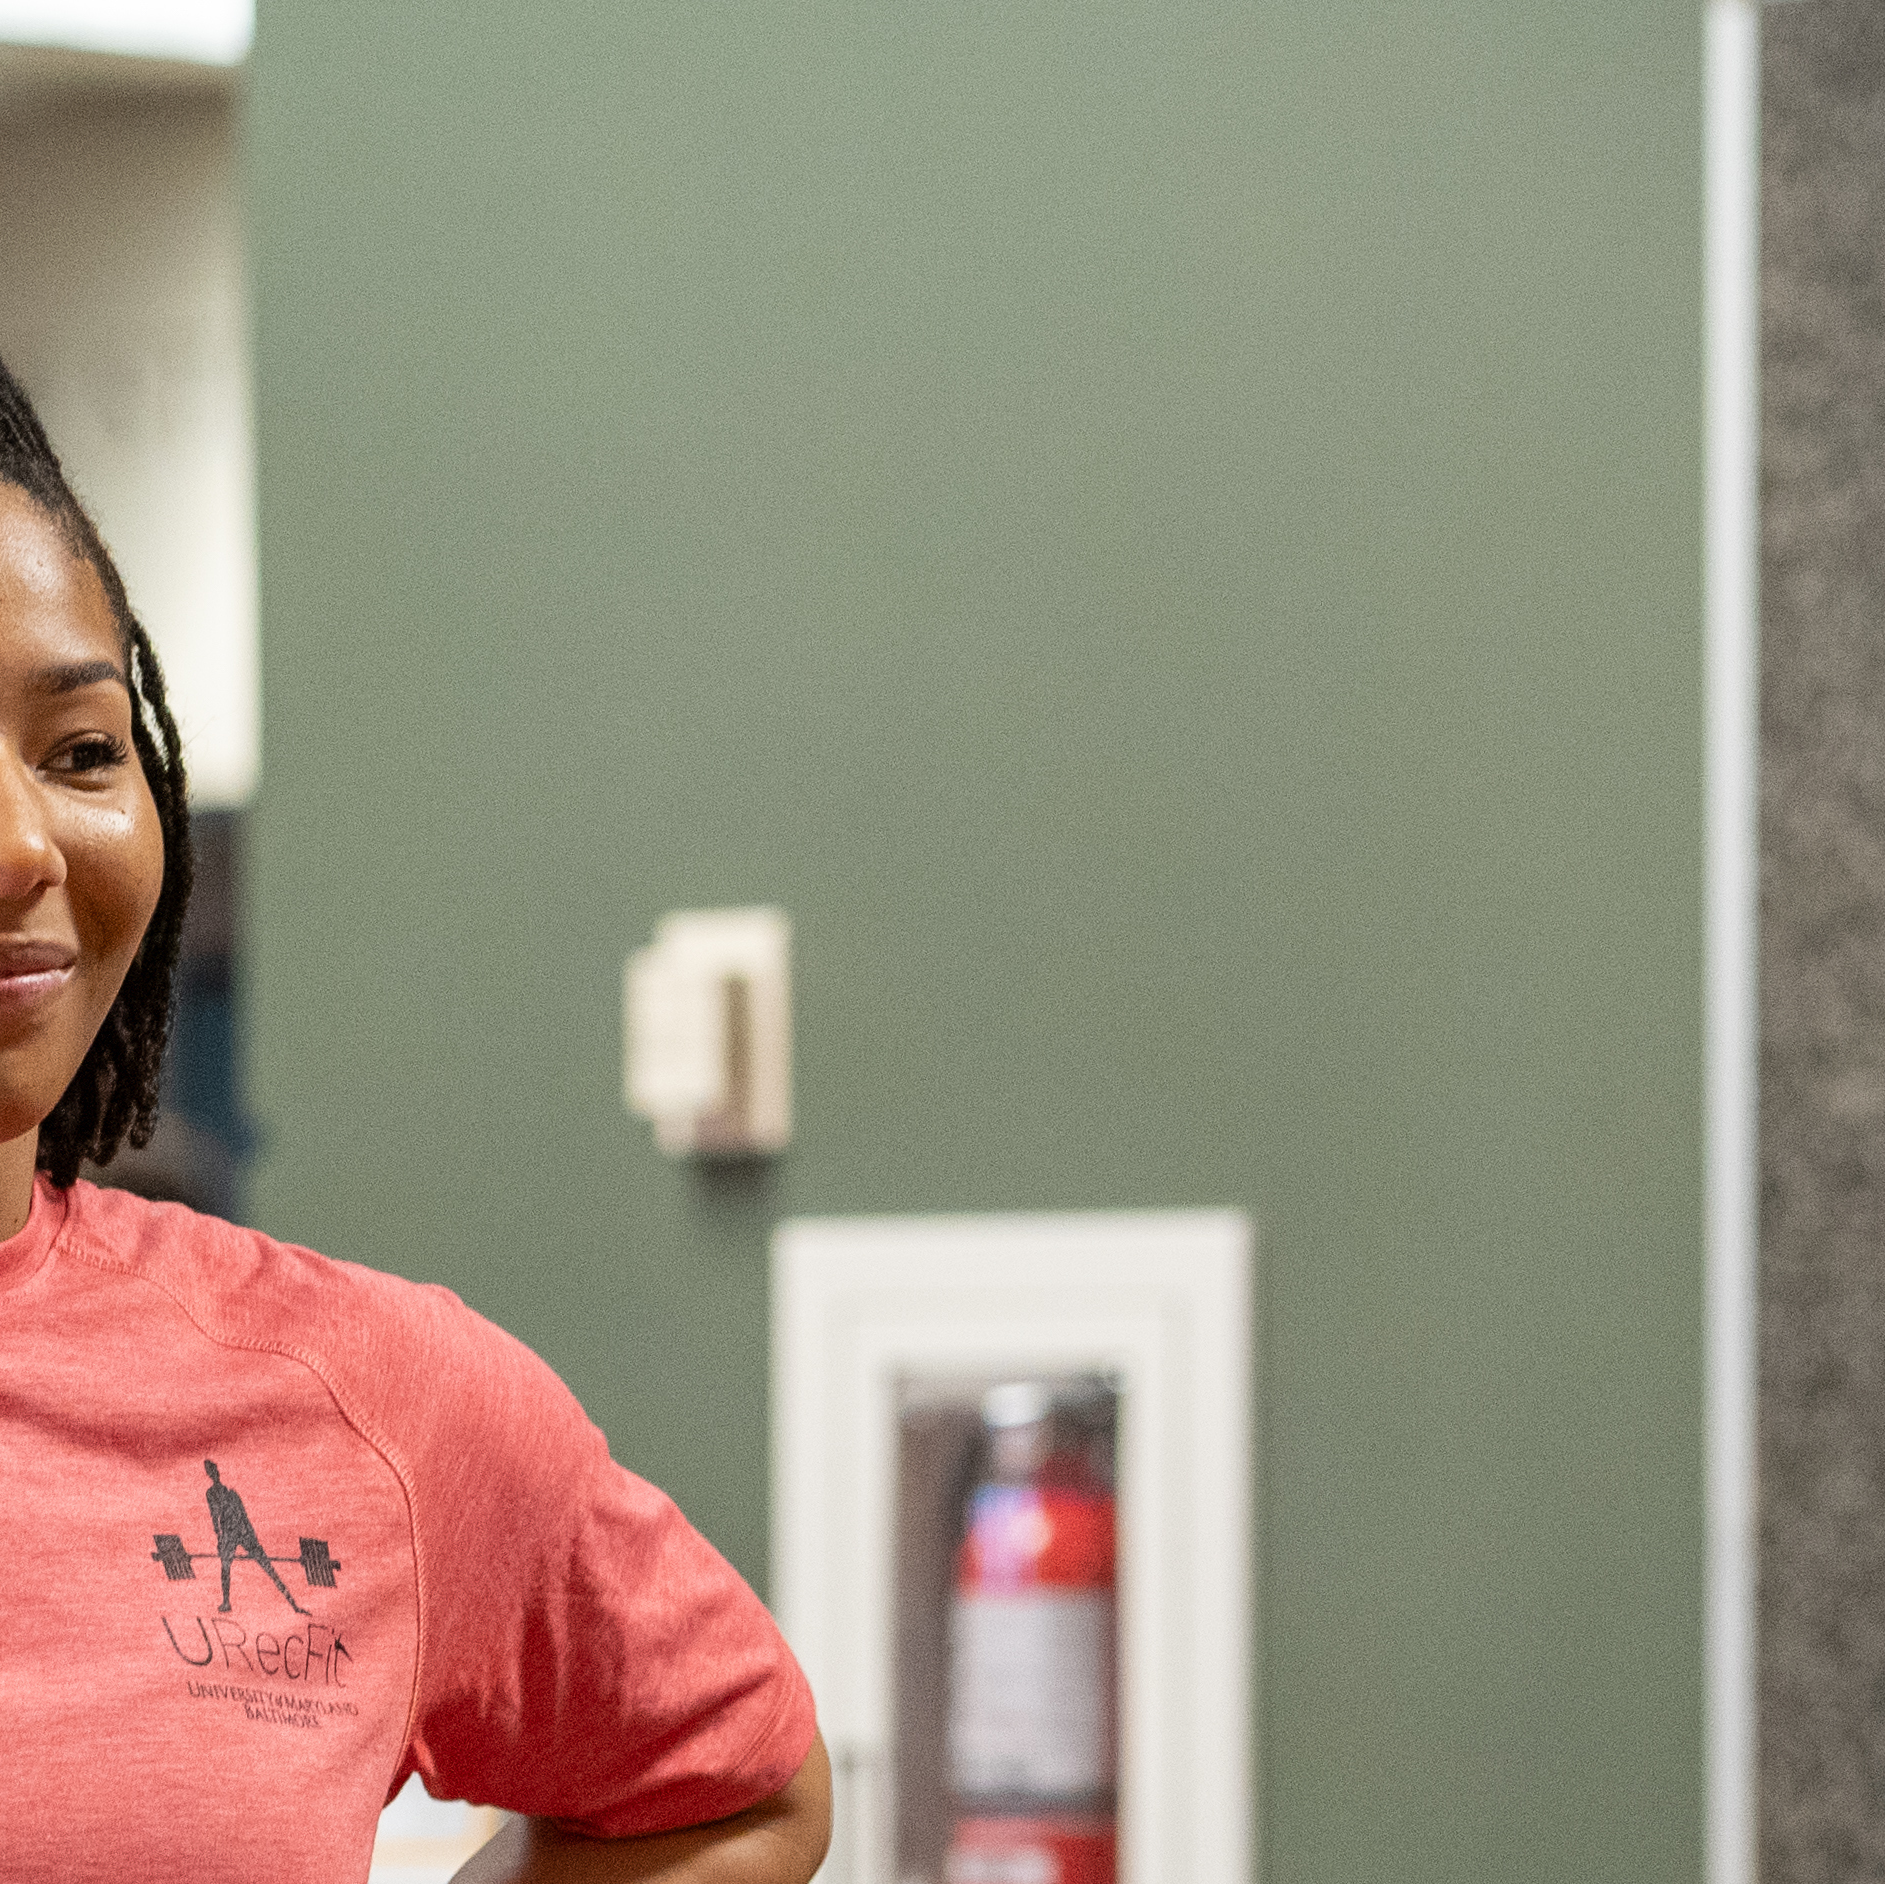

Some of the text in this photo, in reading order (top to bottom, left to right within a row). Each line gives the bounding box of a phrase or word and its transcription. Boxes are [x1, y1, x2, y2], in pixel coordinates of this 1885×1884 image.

[188, 1680, 274, 1706] UNIVERSITY
[283, 1693, 359, 1717] MARYLAND
[243, 1702, 322, 1729] BALTIMORE
